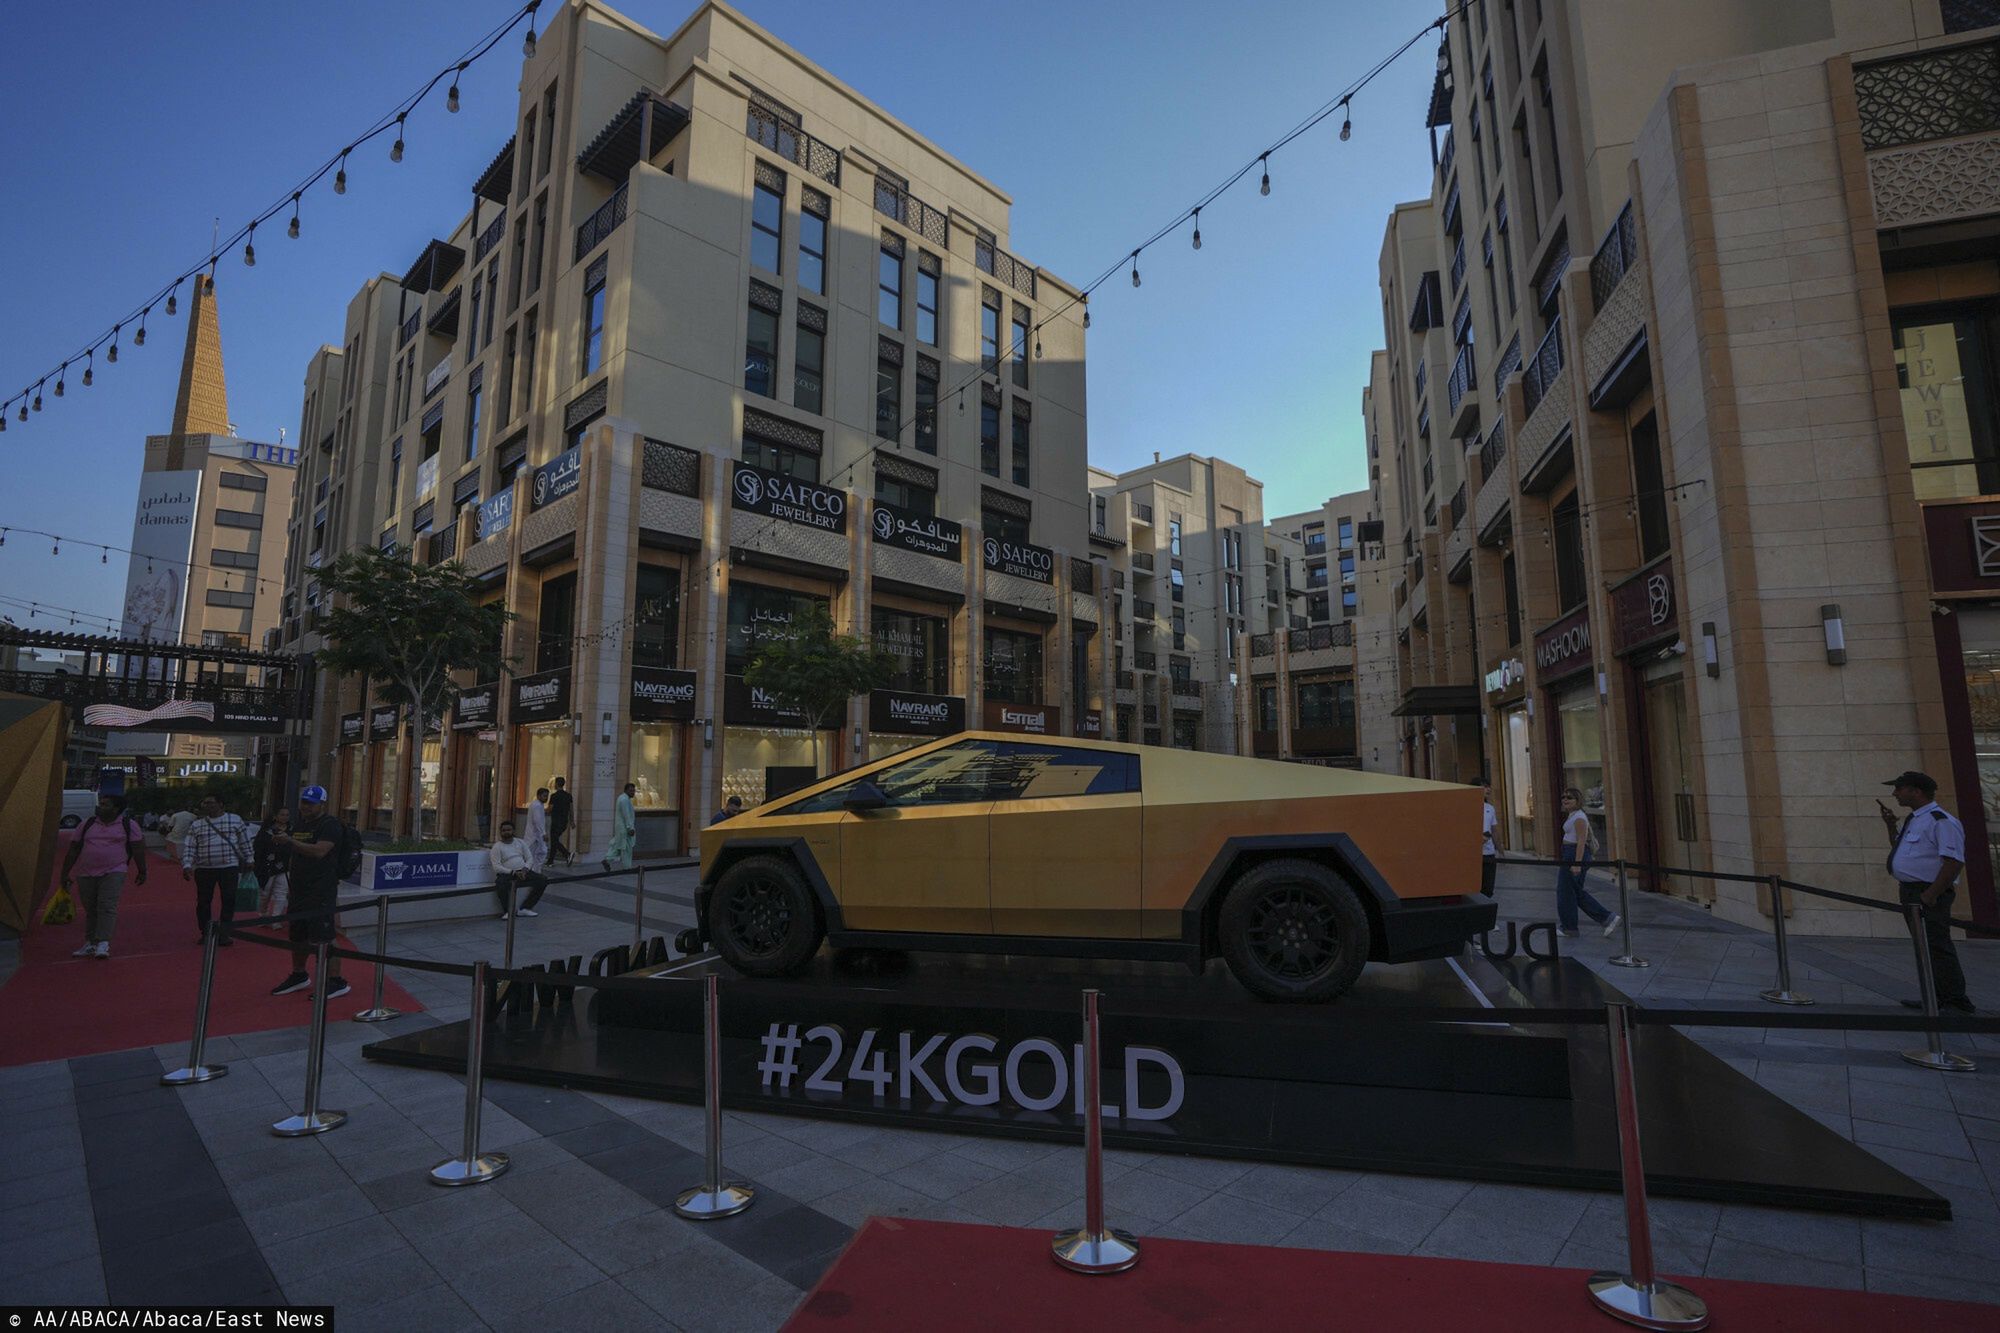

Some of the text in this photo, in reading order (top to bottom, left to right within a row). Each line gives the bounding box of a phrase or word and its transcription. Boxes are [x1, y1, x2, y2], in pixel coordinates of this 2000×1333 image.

[766, 477, 843, 515] SAFCO
[140, 512, 189, 525] damas
[770, 502, 838, 530] JEWELLERY
[896, 519, 960, 544] سافكو
[905, 535, 948, 553] للمجوهرات
[1002, 543, 1051, 570] SAFCO
[1004, 562, 1049, 582] JEWELLERY
[1536, 621, 1592, 670] MASHOOM
[633, 680, 695, 696] NAVRANG
[890, 698, 948, 716] NAVRANG
[179, 760, 237, 777] داماس
[411, 863, 454, 876] JAMAL
[757, 1021, 1186, 1121] #24KGOLD
